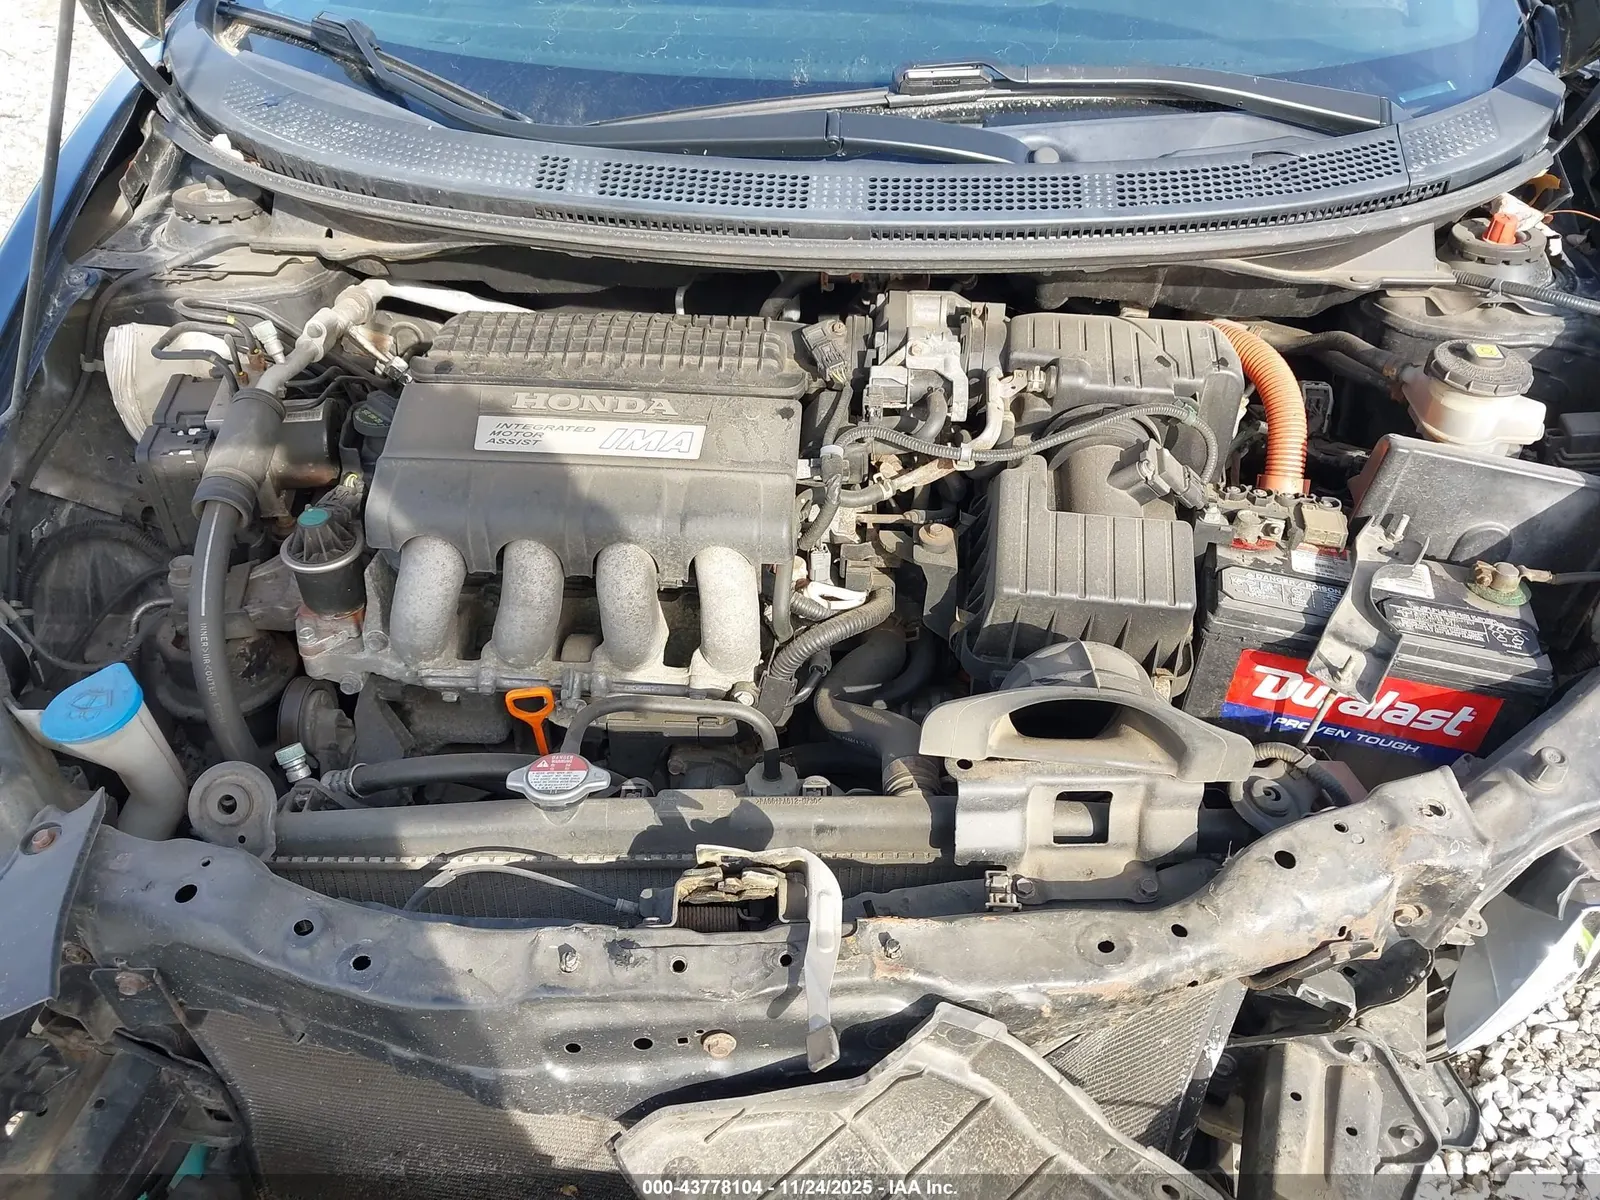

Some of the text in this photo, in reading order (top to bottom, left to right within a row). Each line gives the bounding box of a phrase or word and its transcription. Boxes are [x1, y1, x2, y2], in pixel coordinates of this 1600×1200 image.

[510, 392, 678, 416] HONDA
[489, 430, 545, 438] MOTOR
[495, 422, 596, 433] INTEGRATED
[485, 438, 542, 446] ASSIST
[598, 427, 694, 453] IMA
[1255, 573, 1296, 586] DANGER
[1305, 582, 1342, 594] POISON
[1356, 733, 1421, 753] TOUGH
